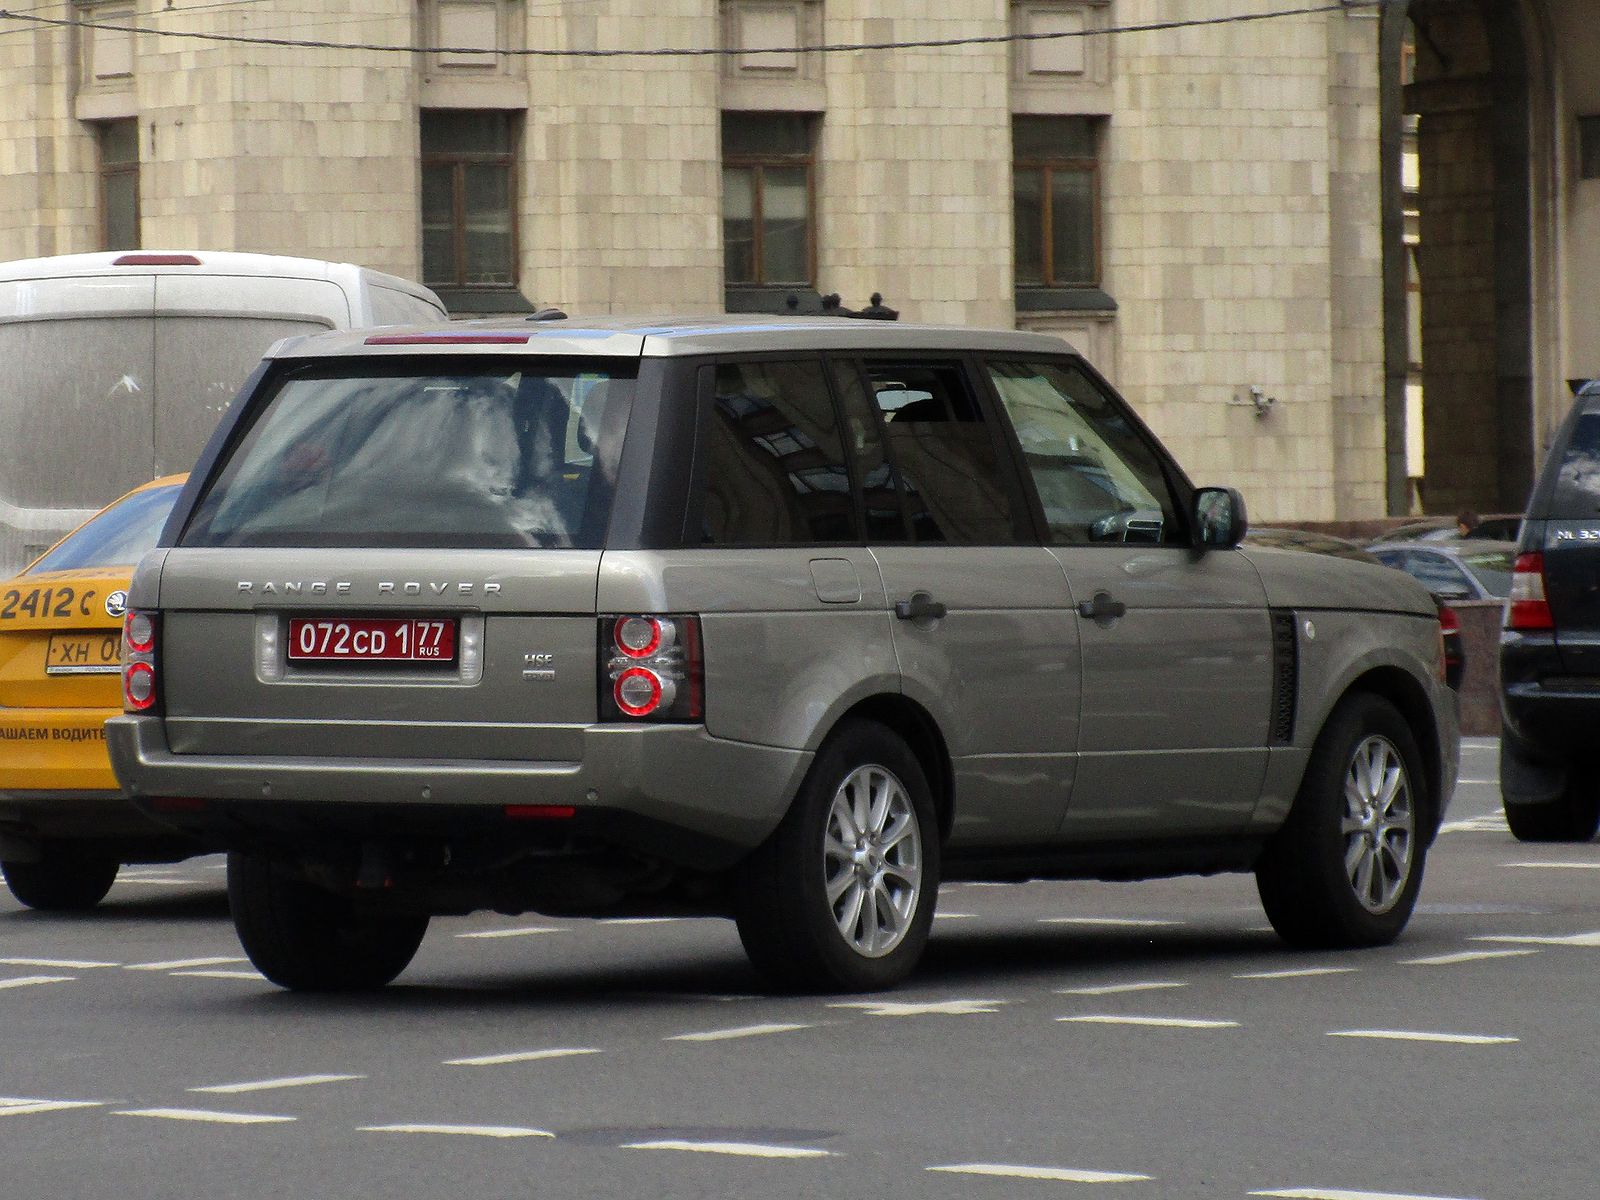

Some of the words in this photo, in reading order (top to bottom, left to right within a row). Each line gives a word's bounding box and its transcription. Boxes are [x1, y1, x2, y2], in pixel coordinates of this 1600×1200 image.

[1579, 530, 1600, 540] 32
[237, 581, 352, 596] RANGE
[378, 582, 503, 597] ROVER
[1, 587, 75, 618] 2412
[299, 622, 387, 654] 072CD
[417, 622, 445, 646] 77
[60, 643, 90, 662] ХН
[419, 646, 440, 656] RUS
[524, 654, 553, 667] HSE
